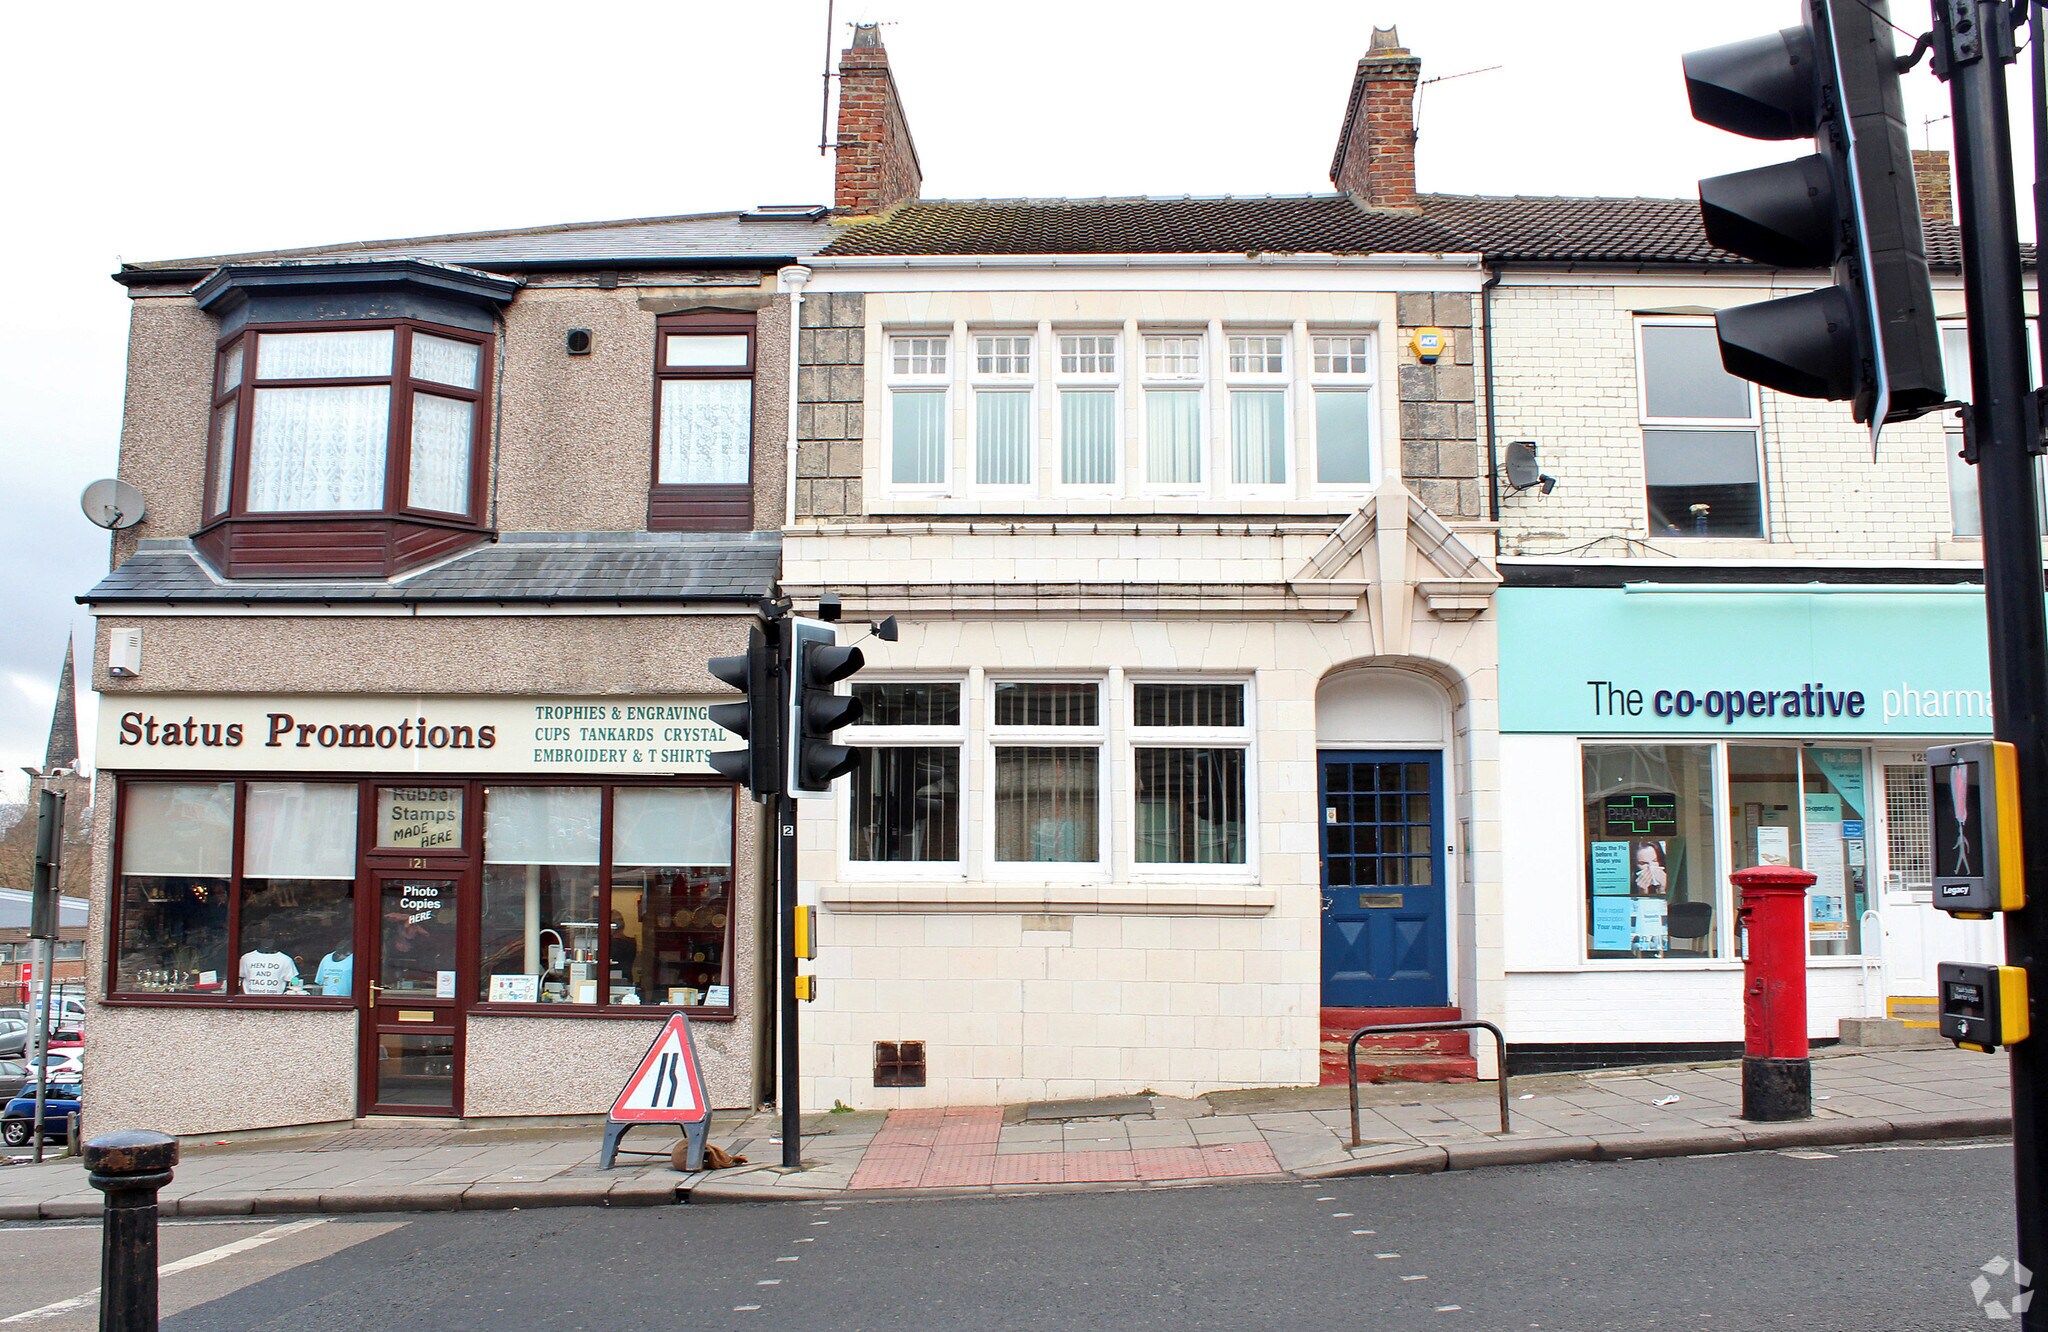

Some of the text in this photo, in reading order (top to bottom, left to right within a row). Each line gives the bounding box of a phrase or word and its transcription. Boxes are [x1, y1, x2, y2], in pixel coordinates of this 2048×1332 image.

[1421, 336, 1437, 345] ADT
[1587, 681, 1643, 716] The
[1653, 682, 1866, 724] co-operative
[535, 706, 708, 720] TROPHIES & ENGRAVING
[119, 711, 497, 750] Status Promotions
[535, 728, 727, 742] CUPS TANKARDS CRYSTAL
[533, 748, 711, 763] EMBROIDERY & T SHIRTS
[393, 788, 454, 802] Rubber
[391, 806, 456, 824] Stamps
[1608, 808, 1673, 821] PHARMACY
[393, 823, 429, 842] MADE
[784, 826, 792, 835] 2
[421, 830, 453, 848] HERE
[409, 858, 427, 869] 121
[403, 886, 439, 897] Photo
[1943, 885, 1969, 896] Legacy
[400, 898, 441, 911] Copies
[408, 910, 432, 925] HERE
[268, 962, 280, 970] DO
